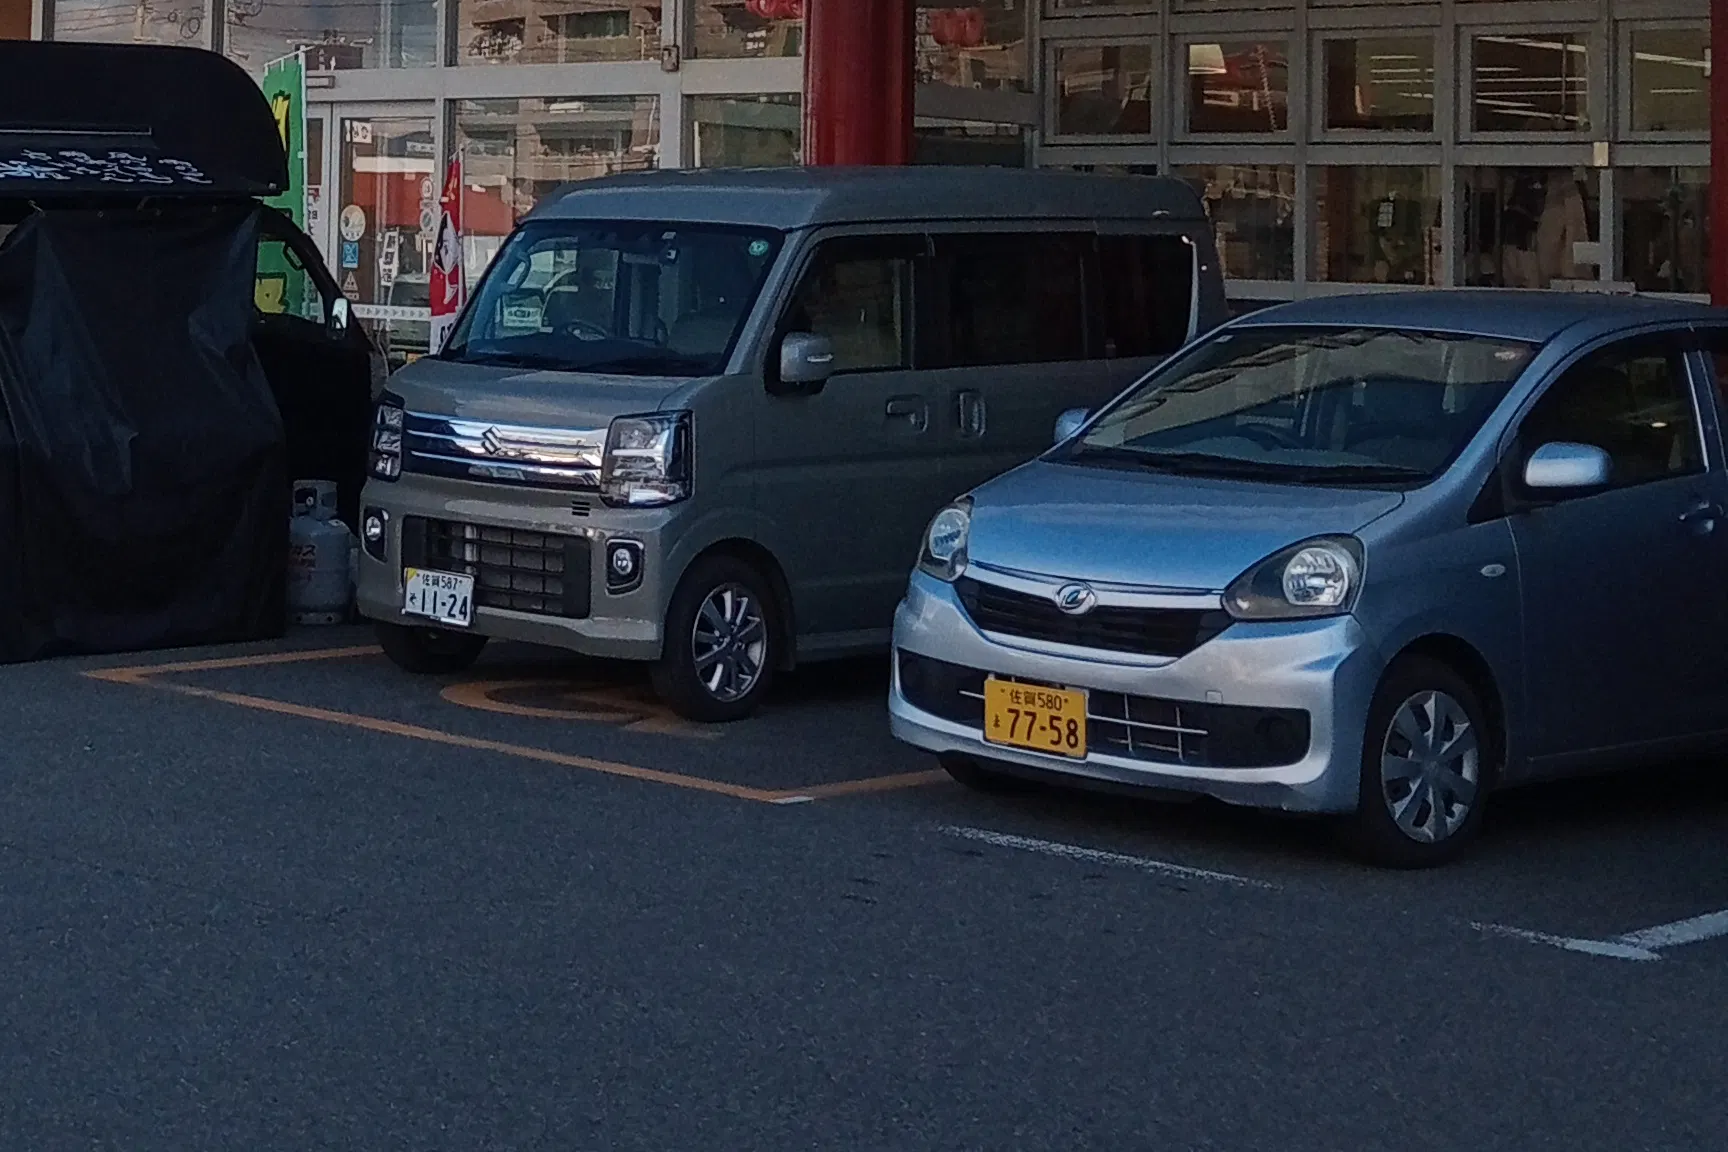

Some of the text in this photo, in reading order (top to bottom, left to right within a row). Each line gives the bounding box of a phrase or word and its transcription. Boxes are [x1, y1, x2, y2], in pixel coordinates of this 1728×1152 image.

[421, 589, 468, 620] 11-24
[1010, 688, 1063, 711] 佐賀580
[1007, 708, 1079, 749] 77-58
